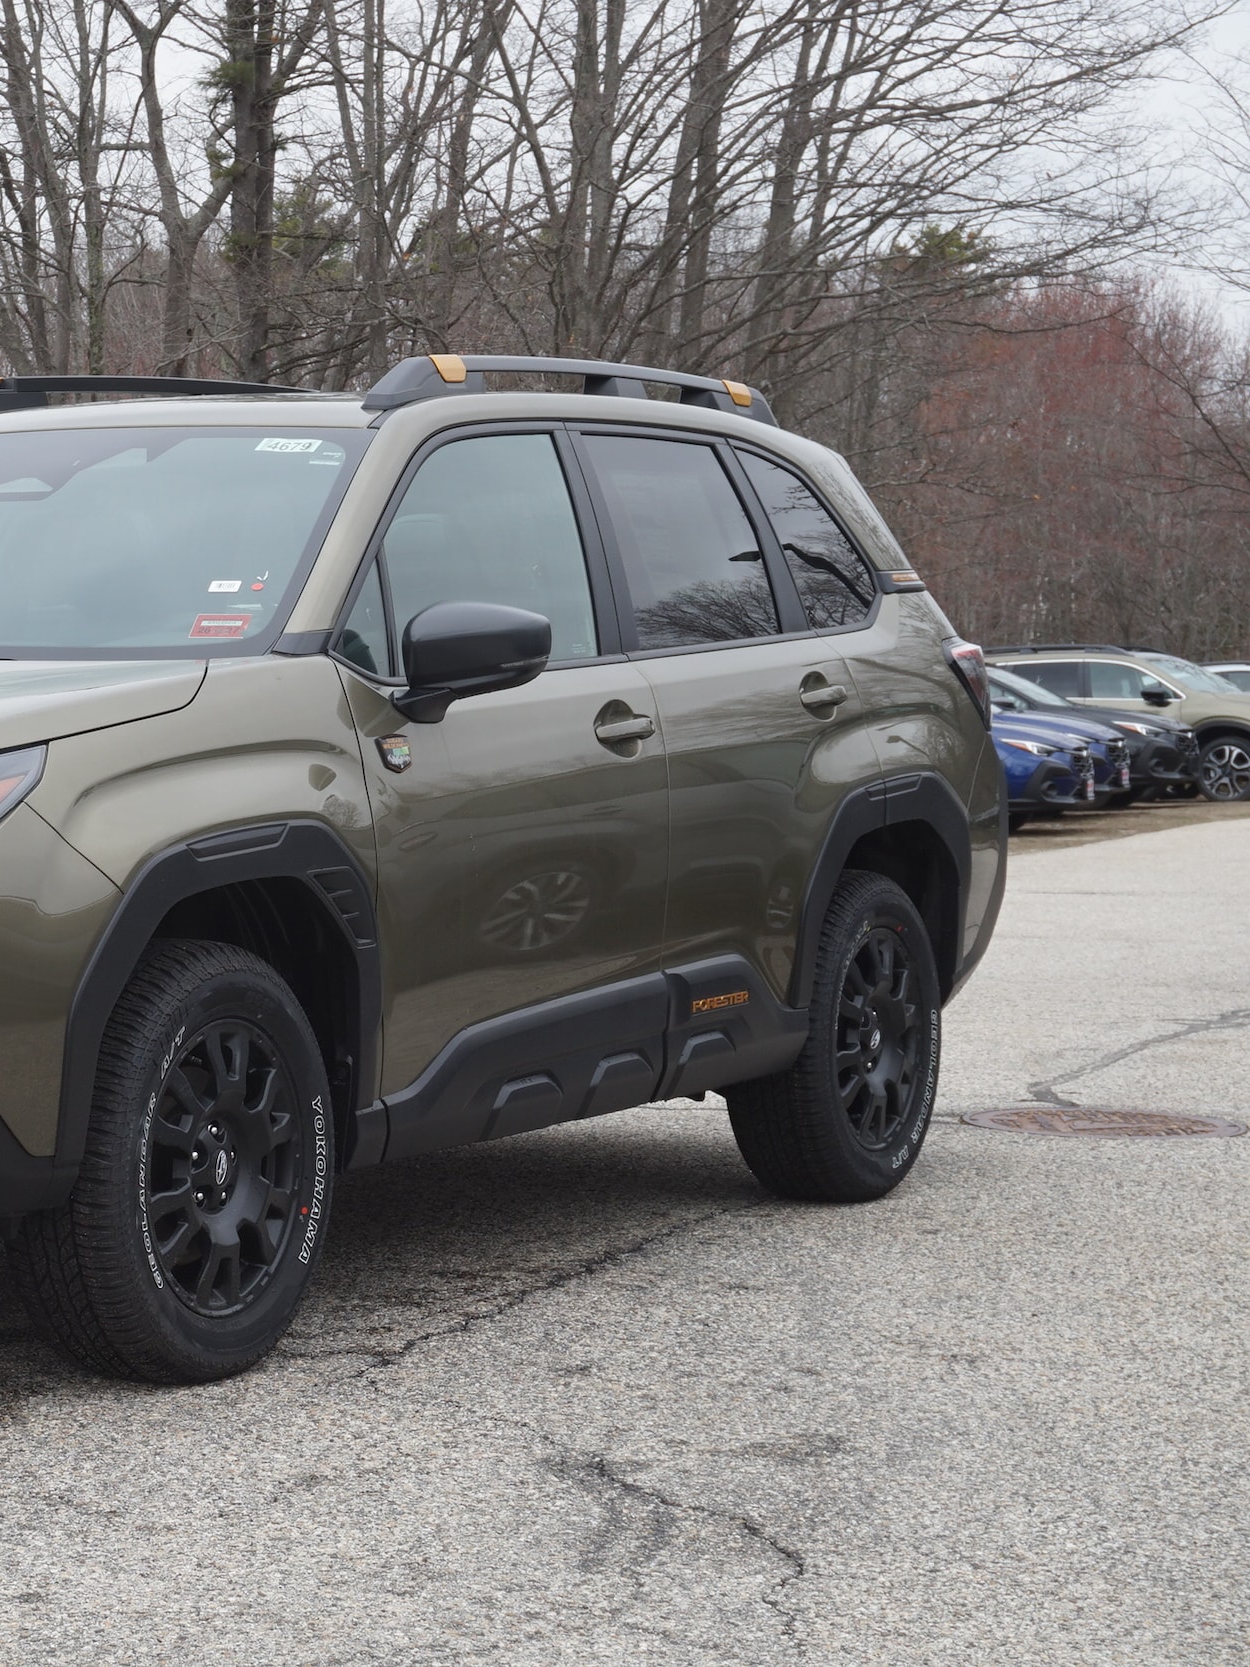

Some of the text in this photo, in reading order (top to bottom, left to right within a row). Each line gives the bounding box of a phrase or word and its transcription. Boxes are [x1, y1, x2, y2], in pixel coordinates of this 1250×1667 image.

[267, 441, 312, 451] 4679
[692, 990, 749, 1013] FORESTER
[911, 1009, 938, 1144] GEOLANDAR
[138, 1026, 186, 1289] GEOLANDAR A/T
[298, 1095, 328, 1265] YOKOHAMA
